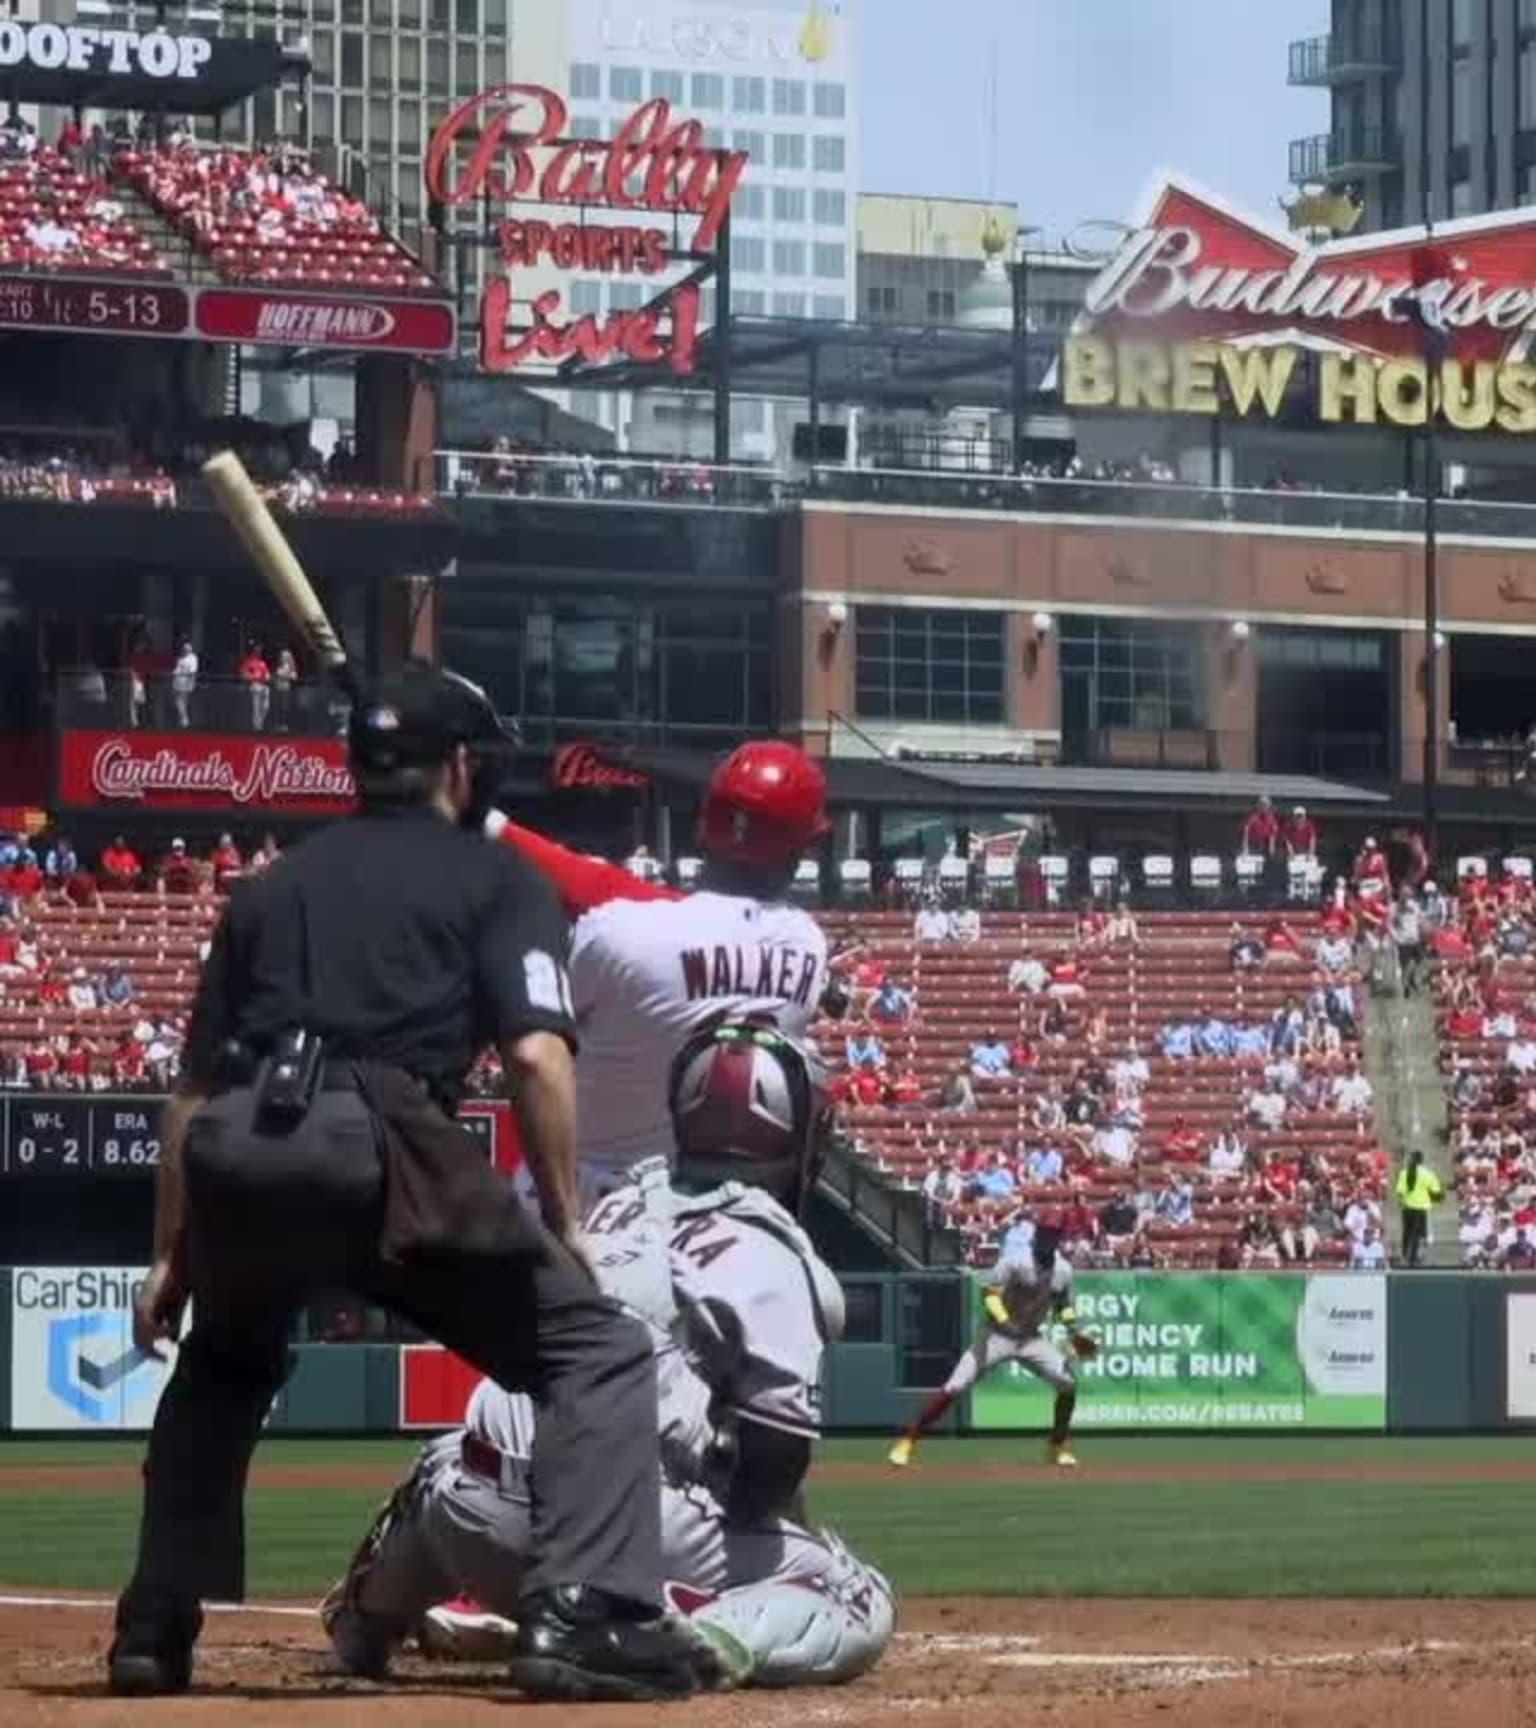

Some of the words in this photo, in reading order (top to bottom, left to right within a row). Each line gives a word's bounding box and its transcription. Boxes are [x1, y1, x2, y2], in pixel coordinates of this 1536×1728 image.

[426, 84, 748, 253] Bally
[499, 219, 668, 275] SPORTS
[88, 292, 160, 325] 5-13
[257, 302, 375, 334] HOFFMANN
[481, 275, 700, 376] Live!
[1064, 336, 1301, 419] BREW
[93, 740, 235, 798] Cardinals
[231, 745, 356, 802] Nation
[680, 946, 818, 1007] WALKER
[32, 1113, 64, 1129] W-L
[114, 1113, 147, 1130] ERA
[104, 1141, 160, 1164] 8.62
[16, 1271, 146, 1309] CarShi
[1074, 1295, 1140, 1318] RGY
[1083, 1353, 1177, 1377] HOME
[1190, 1353, 1256, 1377] RUN
